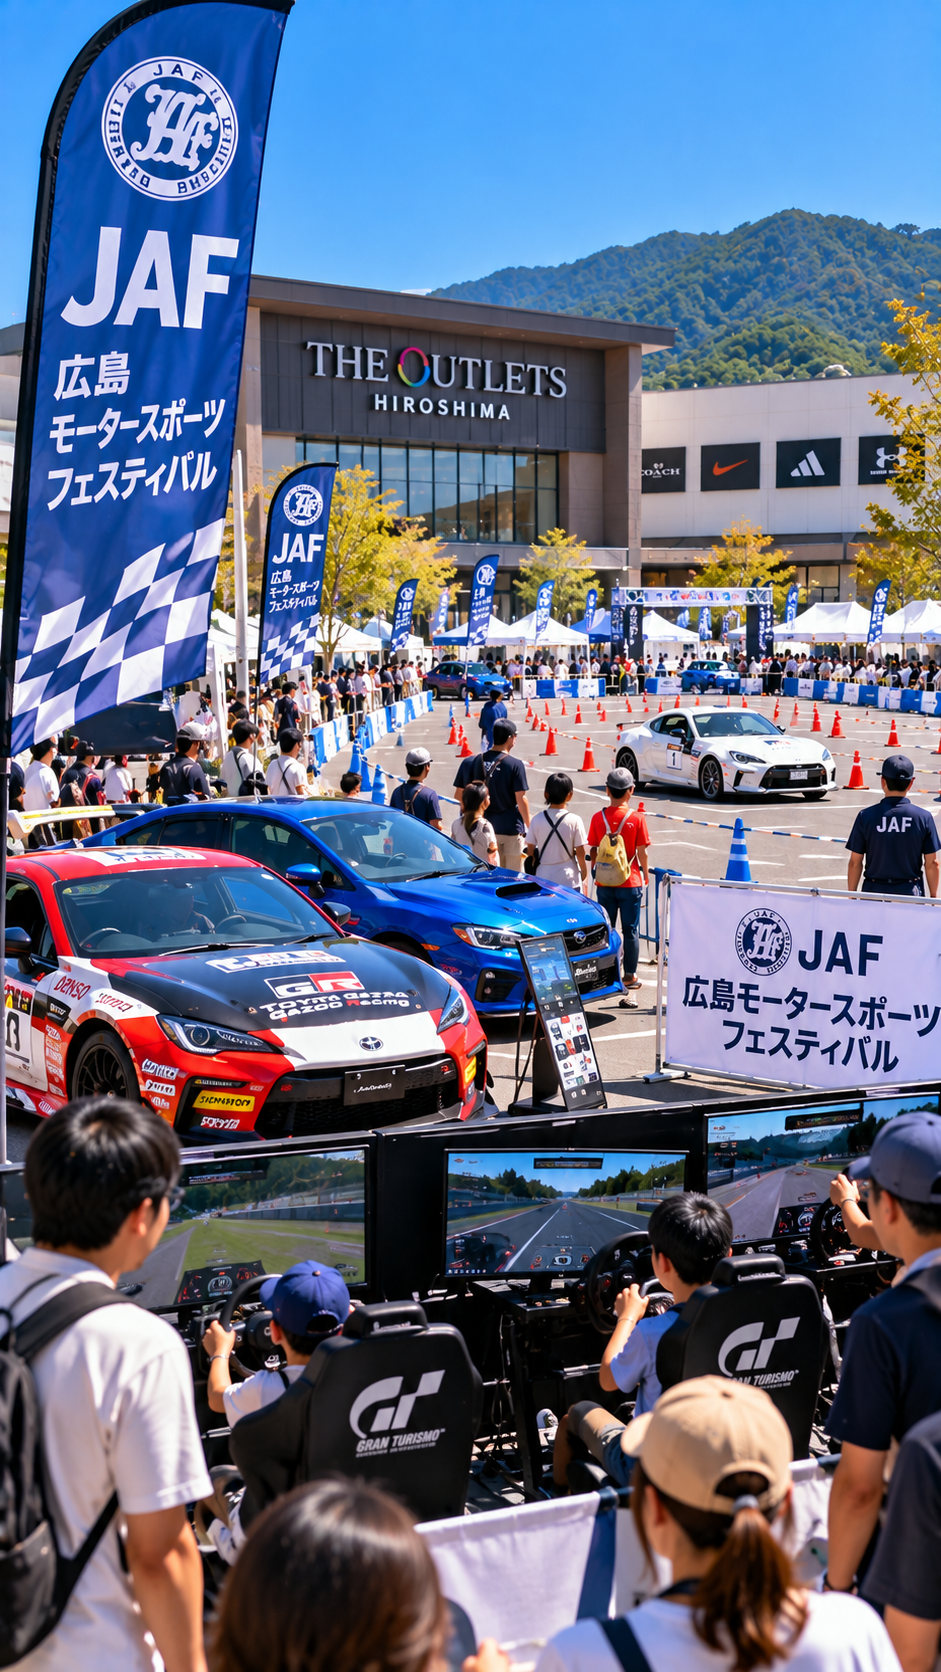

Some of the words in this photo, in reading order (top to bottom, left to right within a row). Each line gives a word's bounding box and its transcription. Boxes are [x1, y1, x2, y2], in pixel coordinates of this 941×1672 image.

[153, 63, 204, 82] JAF
[60, 226, 240, 330] JAF
[53, 351, 131, 402] 広島
[306, 341, 389, 383] THE
[397, 346, 567, 399] OUTLETS
[374, 394, 511, 421] HIROSHIMA
[49, 398, 226, 454] モータースポーツ
[272, 533, 325, 564] JAF
[270, 569, 292, 584] 広島
[672, 752, 677, 766] 1
[876, 816, 912, 833] JAF
[798, 929, 884, 977] JAF
[275, 979, 364, 997] GR
[682, 975, 941, 1038] 広島モータースポーツ
[753, 1370, 795, 1386] TURISMO
[356, 1436, 390, 1453] GRAN
[391, 1429, 440, 1447] TURISMO
